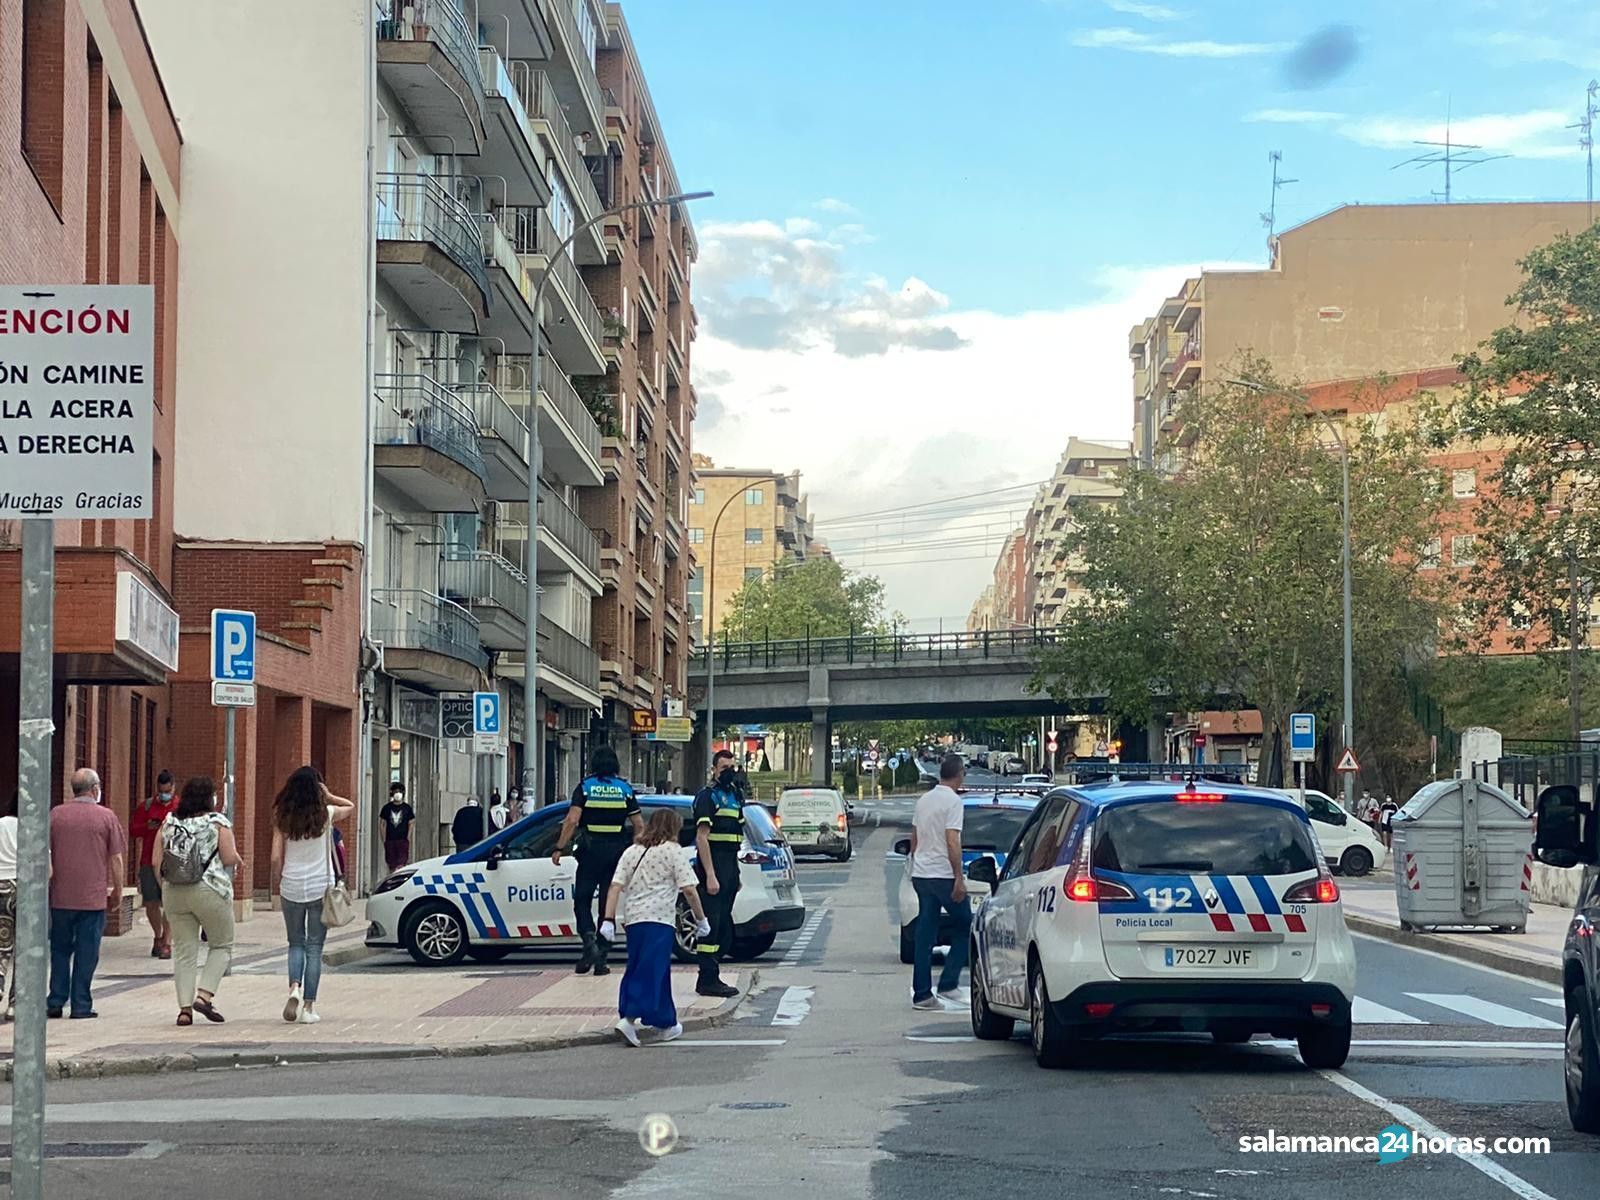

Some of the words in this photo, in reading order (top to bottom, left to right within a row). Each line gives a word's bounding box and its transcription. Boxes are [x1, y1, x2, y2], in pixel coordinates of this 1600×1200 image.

[43, 365, 144, 384] CAMINE
[2, 400, 32, 419] LA
[50, 400, 134, 418] ACERA
[18, 435, 135, 453] DERECHA
[0, 493, 63, 508] Muchas
[76, 492, 143, 508] Gracias
[507, 884, 565, 903] Policía
[1037, 886, 1056, 913] 112
[1143, 887, 1193, 908] 112
[1290, 905, 1307, 914] 705
[1116, 917, 1147, 928] Policía
[1149, 918, 1173, 928] Local
[1175, 949, 1215, 965] 7027
[1223, 949, 1252, 965] JVF
